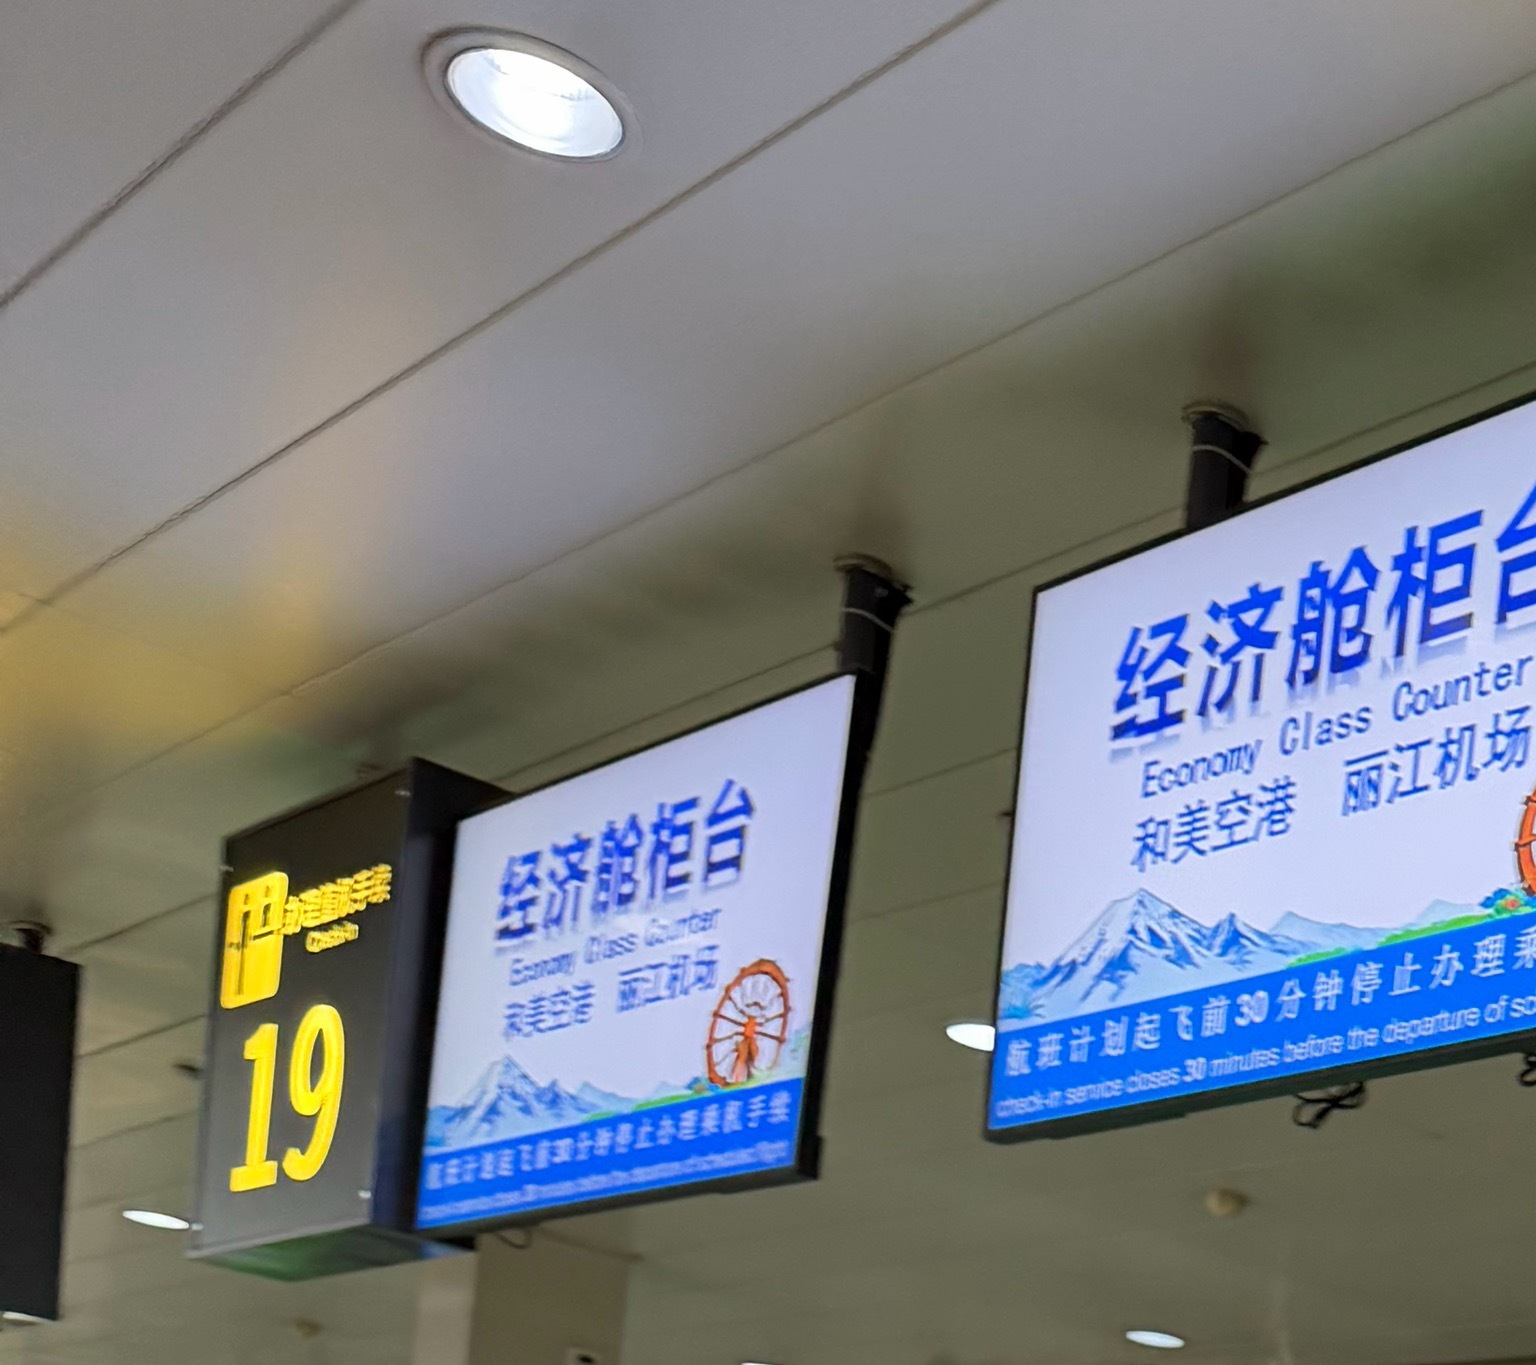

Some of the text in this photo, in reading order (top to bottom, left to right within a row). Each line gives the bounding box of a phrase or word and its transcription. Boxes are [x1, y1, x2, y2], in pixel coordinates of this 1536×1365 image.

[1131, 705, 1533, 873] 和美空港 丽江机场
[1142, 654, 1534, 799] Economy Class Counter
[494, 777, 756, 941] 经济舱柜台
[229, 1003, 345, 1192] 19
[1182, 1056, 1208, 1083] 30
[1209, 1047, 1280, 1076] minutes
[1283, 1033, 1344, 1064] before
[1347, 1025, 1380, 1050] the
[1382, 1004, 1480, 1045] departure
[1484, 995, 1509, 1023] of
